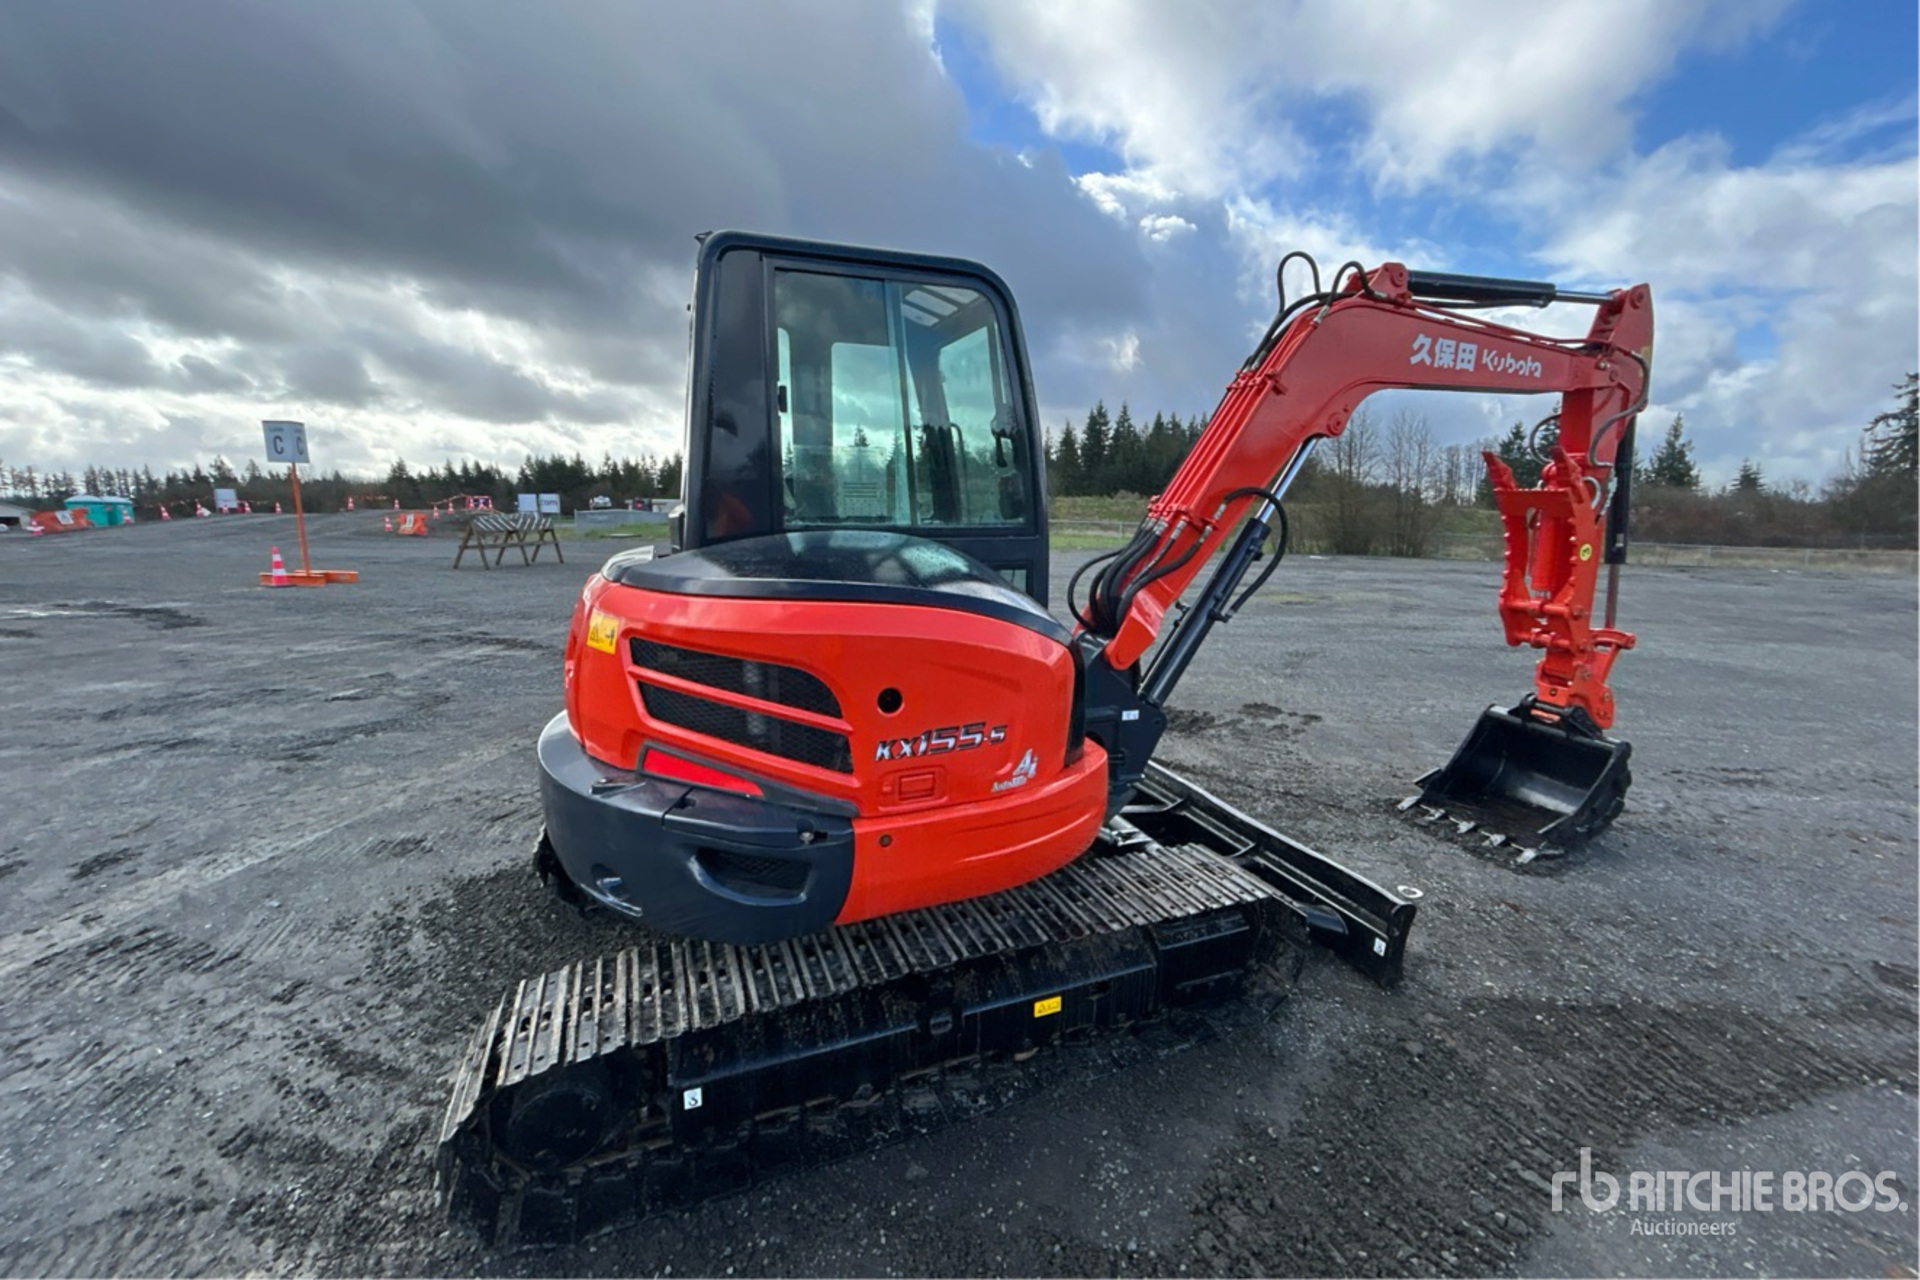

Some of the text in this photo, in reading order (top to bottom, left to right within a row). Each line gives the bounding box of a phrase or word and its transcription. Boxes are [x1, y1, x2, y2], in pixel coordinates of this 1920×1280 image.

[1409, 333, 1478, 372] 久保田
[1482, 348, 1542, 378] Kubota
[273, 435, 284, 455] C
[296, 436, 304, 455] C
